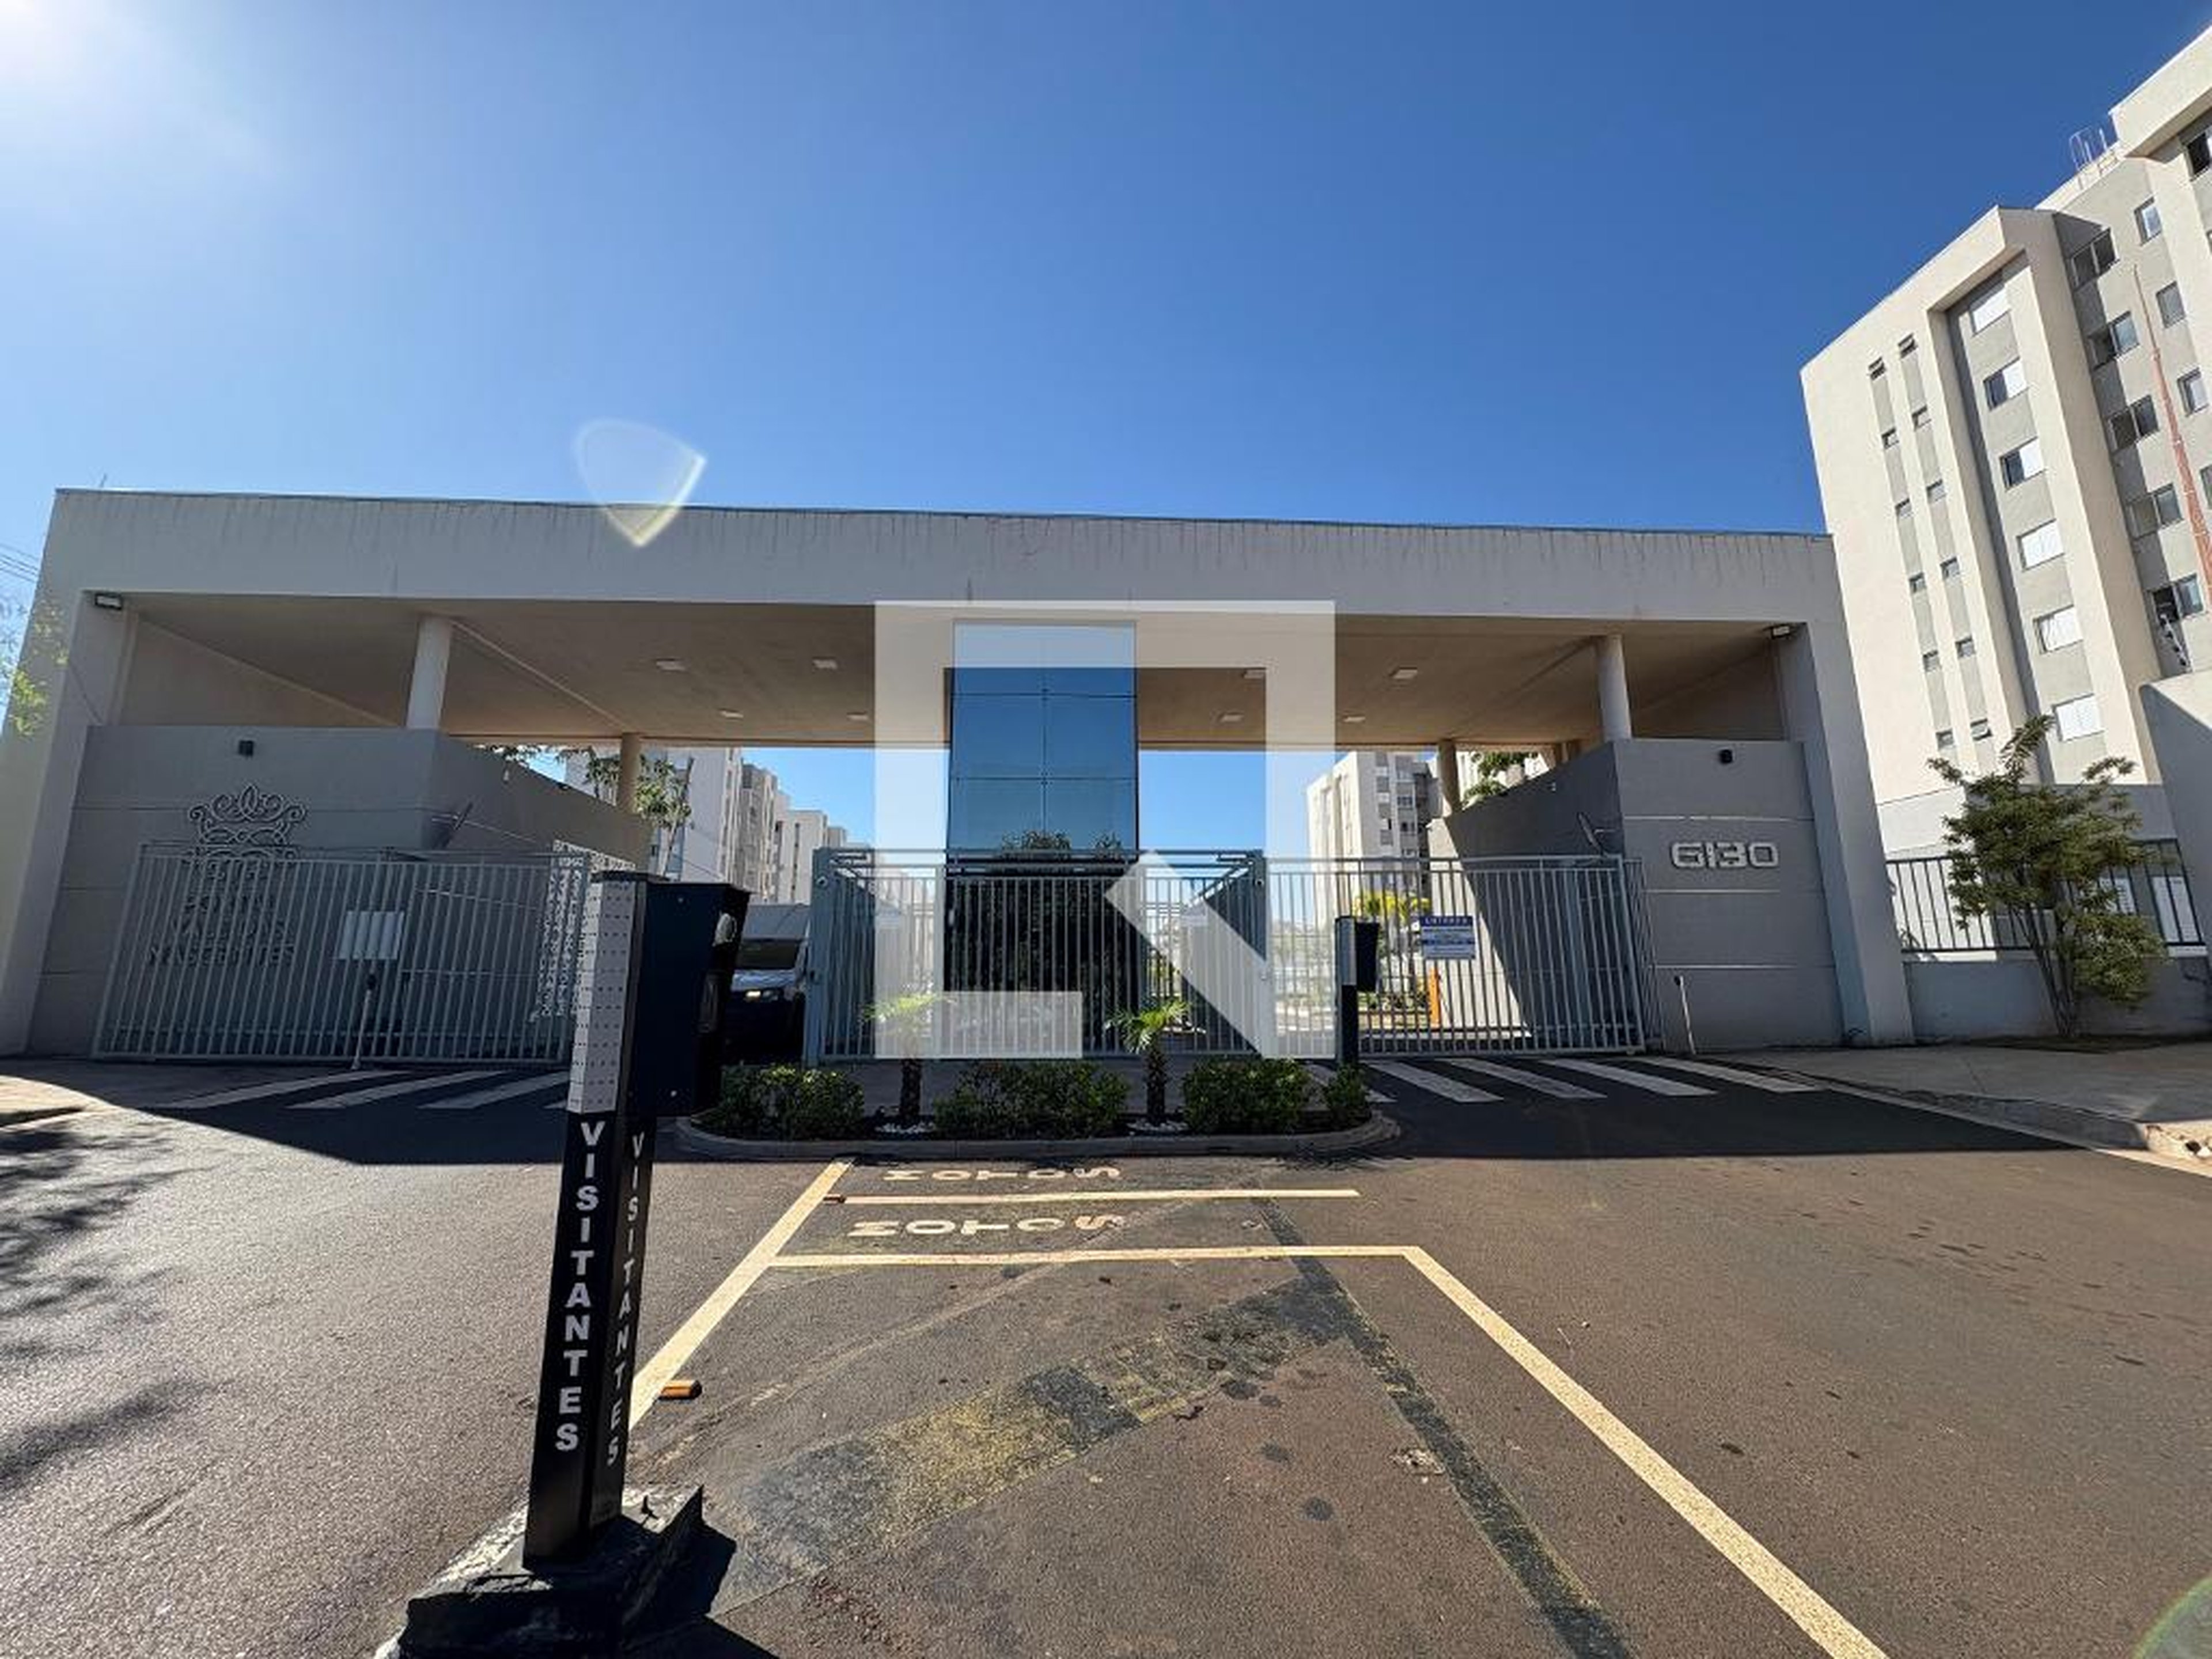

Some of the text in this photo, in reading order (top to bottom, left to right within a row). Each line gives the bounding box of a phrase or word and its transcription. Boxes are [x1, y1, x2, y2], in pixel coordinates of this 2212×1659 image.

[555, 1121, 605, 1452] VISITANTES
[607, 1132, 645, 1467] VISITANTES
[882, 1166, 1121, 1181] MOTOS
